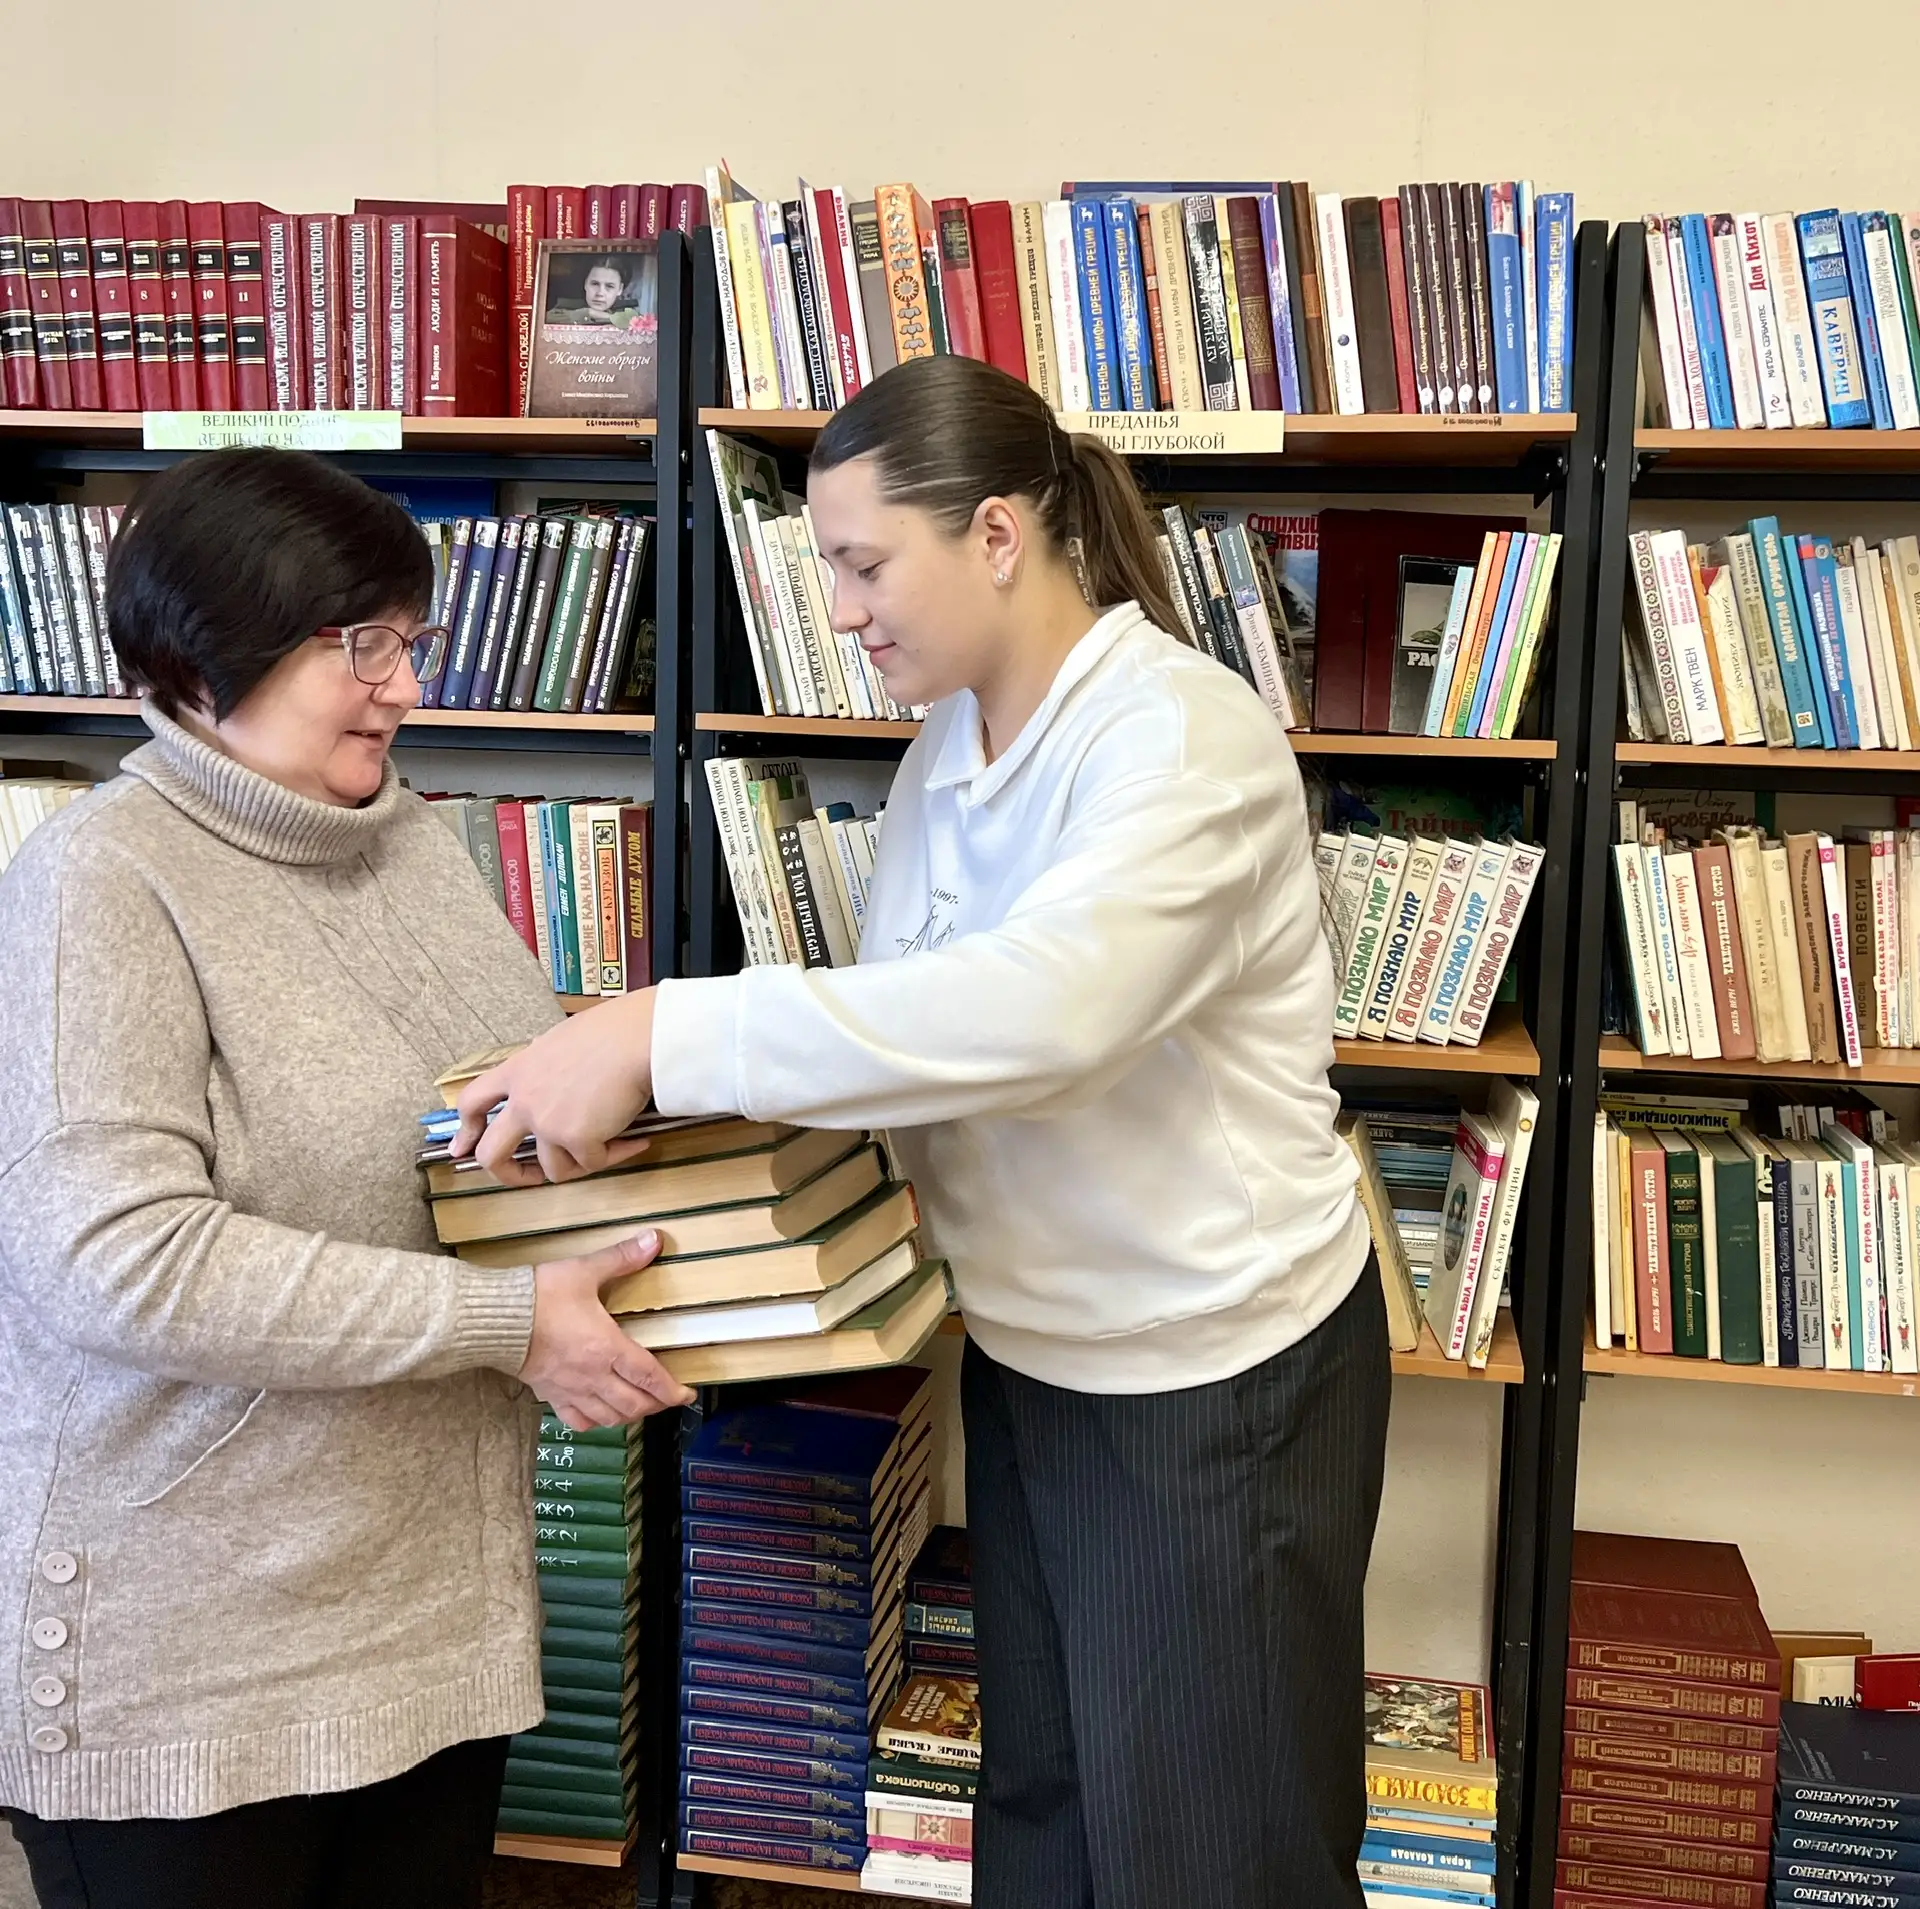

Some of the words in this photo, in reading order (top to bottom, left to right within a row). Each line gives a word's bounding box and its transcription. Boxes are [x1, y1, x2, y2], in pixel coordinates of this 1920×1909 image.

[524, 204, 535, 232] районы
[590, 200, 598, 234] область
[618, 200, 626, 234] область
[647, 198, 656, 232] область
[832, 196, 850, 247] БЫЛИНЫ
[1083, 227, 1097, 266] ГРЕЦИИ
[1113, 227, 1129, 267] ГРЕЦИИ
[1740, 220, 1762, 262] Кихот
[268, 223, 286, 307] ОТЕЧЕСТВЕННОЙ
[308, 223, 324, 307] ОТЕЧЕСТВЕННОЙ
[349, 223, 365, 308] ОТЕЧЕСТВЕННОЙ
[390, 224, 404, 309] ОТЕЧЕСТВЕННОЙ
[431, 241, 440, 284] ПАМЯТЬ
[1747, 265, 1766, 292] Дон
[202, 289, 214, 300] 10
[238, 292, 248, 302] 11
[1086, 269, 1102, 314] ДРЕВНЕЙ
[1502, 285, 1514, 317] Баллады
[431, 299, 440, 332] ЛЮДИ
[1092, 317, 1106, 349] МИФЫ
[1756, 304, 1771, 347] СЕРВАНТЕС
[272, 311, 288, 358] ВЕЛИКОЙ
[310, 311, 325, 357] ВЕЛИКОЙ
[352, 313, 367, 359] ВЕЛИКОЙ
[389, 313, 404, 360] ВЕЛИКОЙ
[517, 313, 529, 358] ПОБЕДОЙ
[1506, 323, 1515, 348] Сказки
[1815, 306, 1857, 396] КАВЕРИН
[431, 345, 440, 380] Баранов
[546, 351, 604, 367] Женские
[608, 354, 651, 368] образы
[577, 368, 615, 384] войны
[1686, 346, 1701, 378] ХОЛМС
[1764, 349, 1776, 378] МИГЕЛЬ
[275, 362, 291, 403] ПИСЬМА
[313, 362, 327, 403] ПИСЬМА
[354, 361, 368, 405] ПИСЬМА
[391, 363, 404, 406] ПИСЬМА
[1096, 361, 1111, 409] ЛЕГЕНДЫ
[1128, 364, 1144, 409] ЛЕГЕНДЫ
[1691, 382, 1706, 420] ШЕРЛОК
[1088, 415, 1180, 430] ПРЕДАНЬЯ
[1132, 434, 1225, 450] ГЛУБОКОЙ
[712, 456, 721, 475] ЧТО
[717, 476, 729, 513] ВНУТРИ
[732, 554, 742, 580] АНИТА
[738, 582, 748, 612] ГЭНЕРИ
[1201, 513, 1225, 522] ЧТО
[768, 540, 783, 567] КРАЙ
[1761, 532, 1785, 598] ВРУНГЕЛЬ
[775, 570, 796, 626] РОДИМЫЙ
[786, 560, 807, 612] ПРИРОДЕ
[798, 615, 808, 623] О
[1811, 592, 1828, 632] РАЗВЯЗКА
[1819, 575, 1840, 639] ПОППИНС
[789, 630, 802, 653] МОЙ
[1775, 600, 1798, 662] КАПИТАН
[795, 655, 806, 672] ТЫ
[801, 626, 823, 683] РАССКАЗЫ
[1243, 608, 1261, 640] Эрнест
[1252, 640, 1283, 710] ХЕМИНГУЭЙ
[1684, 647, 1700, 677] ТВЕН
[1819, 633, 1841, 691] НЕОЖИДАННАЯ
[1830, 643, 1845, 680] МЭРИ
[799, 676, 813, 702] КРАЙ
[1690, 676, 1707, 711] МАРК
[710, 766, 725, 805] ТОМПСОН
[728, 766, 744, 804] ТОМПСОН
[719, 806, 731, 833] СЕТОН
[737, 806, 750, 833] СЕТОН
[576, 853, 589, 887] ВОЙНЕ
[627, 846, 640, 883] ДУХОМ
[1710, 865, 1724, 896] ОСТРОВ
[580, 889, 590, 904] НА
[600, 865, 611, 910] КУТУЗОВ
[790, 871, 808, 897] ГОД
[931, 888, 958, 904] 1997
[1365, 877, 1391, 921] МИР
[1649, 855, 1669, 927] СОКРОВИЩ
[1875, 879, 1883, 914] ШКОЛЕ
[559, 891, 568, 916] ЕВМЕН
[581, 908, 592, 929] КАК
[629, 886, 642, 939] СИЛЬНЫЕ
[780, 911, 790, 922] ДО
[1397, 891, 1421, 929] МИР
[1429, 883, 1456, 925] МИР
[1463, 892, 1487, 932] МИР
[1496, 884, 1523, 929] МИР
[1854, 878, 1869, 954] ПОВЕСТИ
[795, 898, 821, 960] КРУГЛЫЙ
[582, 933, 594, 967] ВОЙНЕ
[790, 949, 798, 959] ОТ
[1342, 926, 1379, 1003] ПОЗНАЮ
[1661, 933, 1676, 981] ОСТРОВ
[1877, 930, 1886, 985] РАССКАЗЫ
[585, 971, 595, 984] НА
[1374, 934, 1408, 1005] ПОЗНАЮ
[1403, 930, 1442, 1008] ПОЗНАЮ
[1436, 935, 1472, 1006] ПОЗНАЮ
[1469, 932, 1508, 1010] ПОЗНАЮ
[1336, 1005, 1356, 1023] Я
[1368, 1007, 1386, 1023] Я
[1726, 987, 1738, 1008] ВЕРН
[1879, 988, 1889, 1040] СМЕШНЫЕ
[1396, 1008, 1417, 1027] Я
[1429, 1008, 1449, 1025] Я
[1461, 1010, 1482, 1030] Я
[1730, 1009, 1742, 1035] ЖЮЛЬ
[1628, 1110, 1729, 1128] ЭНЦИКЛОПЕДИЯ
[1643, 1168, 1655, 1198] ОСТРОВ
[1861, 1160, 1870, 1216] СОКРОВИЩ
[1489, 1232, 1508, 1279] СКАЗКИ
[1500, 1166, 1523, 1226] ФРАНЦИИ
[1643, 1201, 1660, 1273] ТАИНСТВЕННЫЙ
[1796, 1227, 1805, 1253] Антуан
[1682, 1243, 1692, 1271] ОСТРОВ
[1862, 1222, 1871, 1262] ОСТРОВ
[1649, 1286, 1660, 1306] ВЕРН
[1650, 1307, 1662, 1333] ЖЮЛЬ
[1811, 1316, 1819, 1340] Родари
[554, 1480, 572, 1492] 4
[556, 1504, 574, 1518] 3
[560, 1529, 578, 1542] 2
[1386, 1777, 1470, 1807] ЗОЛОТАЯ
[1390, 1848, 1434, 1866] Коллоди
[1440, 1855, 1472, 1870] Карло
